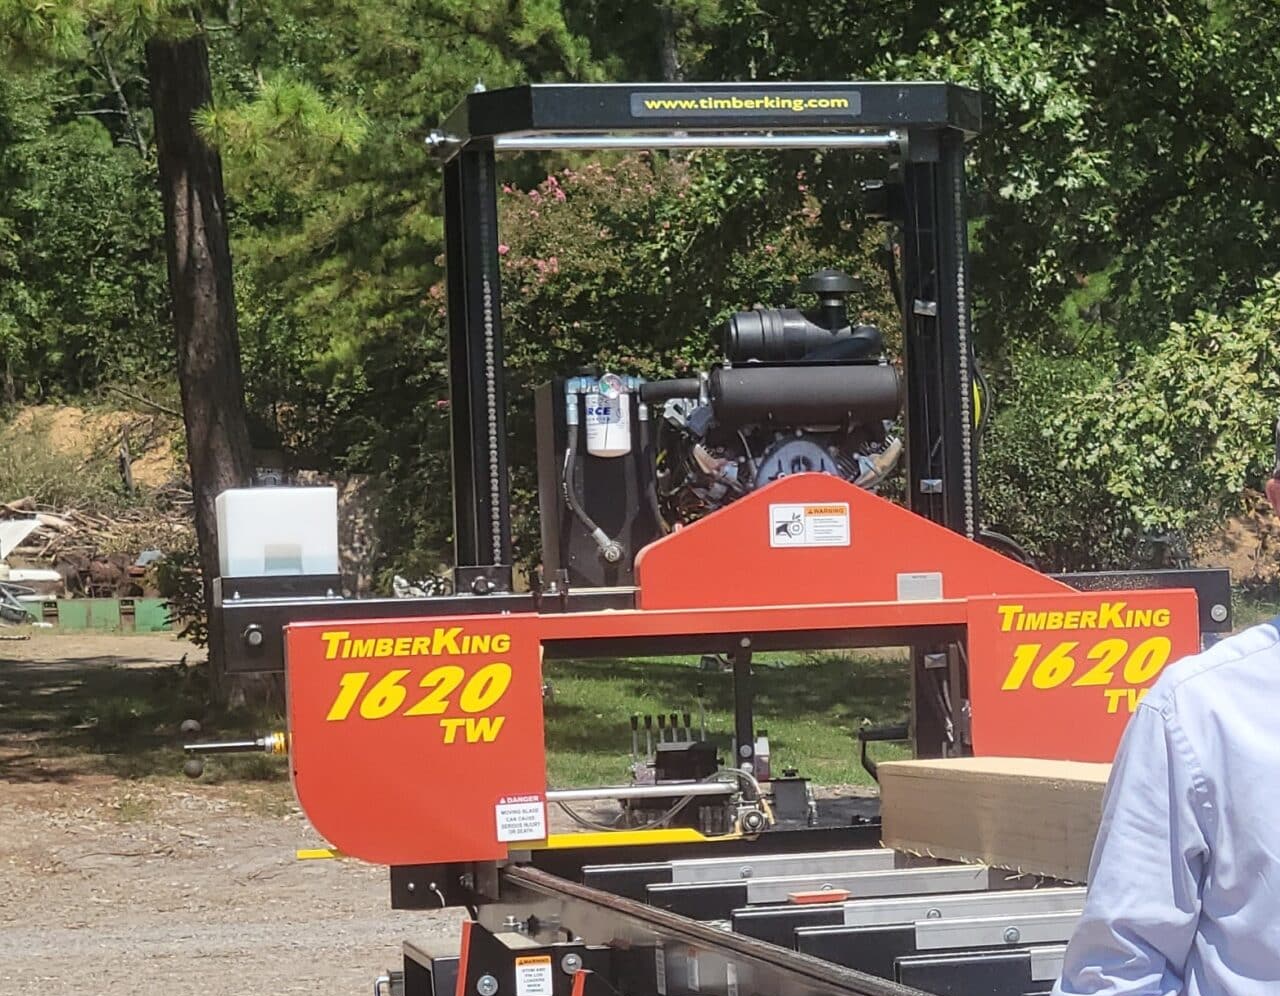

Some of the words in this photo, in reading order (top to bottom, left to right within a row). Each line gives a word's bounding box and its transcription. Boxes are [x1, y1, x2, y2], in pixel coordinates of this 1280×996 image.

[644, 96, 849, 112] www.timberking.com
[1001, 636, 1172, 691] 1620
[326, 662, 513, 721] 1620
[439, 716, 506, 744] TW
[506, 795, 539, 804] DANGER
